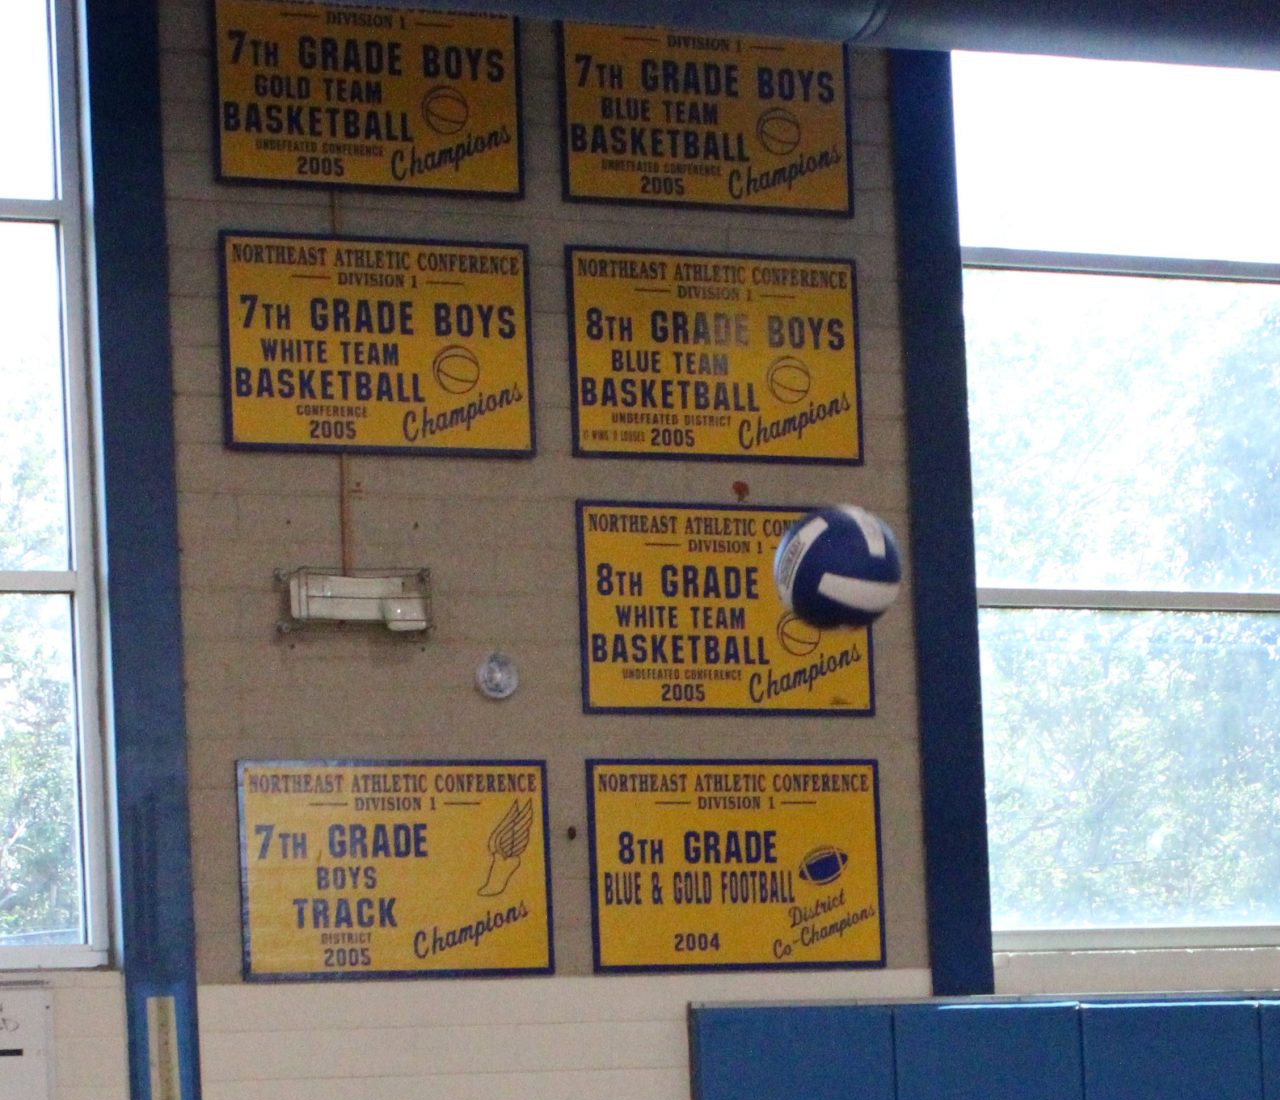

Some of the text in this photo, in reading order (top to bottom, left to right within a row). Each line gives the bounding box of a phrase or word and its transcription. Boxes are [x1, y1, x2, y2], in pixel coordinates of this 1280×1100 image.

[326, 12, 392, 28] DIVISION
[228, 29, 504, 82] 7TH GRADE BOYS
[667, 35, 730, 51] DIVISION
[255, 74, 382, 104] GOLD TEAM
[575, 53, 835, 104] 7TH GRADE BOYS
[223, 101, 414, 143] BASKETBALL
[601, 97, 718, 125] BLUE TEAM
[391, 125, 512, 181] Champions
[571, 123, 750, 163] BASKETBALL
[297, 156, 344, 176] 2005
[728, 148, 841, 199] Champions
[640, 175, 685, 195] 2005
[232, 243, 519, 276] NORTHEAST ATHLETIC CONFERENCE
[337, 272, 418, 288] DIVISION 1
[578, 258, 847, 290] NORTHEAST ATHLETIC CONFERENCE
[677, 285, 741, 301] DIVISION
[240, 294, 515, 340] 7TH GRADE BOYS
[586, 307, 845, 351] 8TH GRADE BOYS
[260, 338, 399, 367] WHITE TEAM
[612, 349, 728, 376] BLUE TEAM
[235, 367, 426, 403] BASKETBALL
[581, 377, 760, 413] BASKETBALL
[296, 404, 368, 419] CONFERENCE
[402, 381, 522, 442] Champions
[612, 412, 731, 427] UNDEFEATED DISTRICT
[738, 392, 850, 449] Champions
[310, 420, 357, 440] 2005
[651, 428, 695, 447] 2005
[589, 514, 678, 535] NORTHEAST
[684, 517, 756, 537] ATHLETIC
[688, 540, 750, 554] DIVISION
[596, 563, 643, 597] 8TH
[661, 564, 759, 600] GRADE
[615, 605, 745, 630] WHITE TEAM
[591, 633, 770, 665] BASKETBALL
[622, 669, 742, 681] UNDEFEATED CONFERENCE
[750, 643, 862, 703] Champions
[661, 684, 705, 702] 2005
[250, 773, 537, 794] NORTHEAST ATHLETIC CONFERENCE
[599, 774, 870, 793] NORTHEAST ATHLETIC CONFERENCE
[354, 797, 436, 811] DIVISION 1
[697, 797, 775, 810] DIVISION 1
[254, 824, 428, 860] 7TH GRADE
[618, 830, 778, 865] 8TH GRADE
[316, 866, 377, 890] BOYS
[605, 870, 795, 906] BLUE & GOLD FOOTBALL
[293, 898, 398, 929] TRACK
[788, 888, 845, 928] District
[321, 932, 372, 945] DISTRICT
[413, 900, 529, 959] Champions
[675, 933, 720, 951] 2004
[324, 948, 371, 967] 2005
